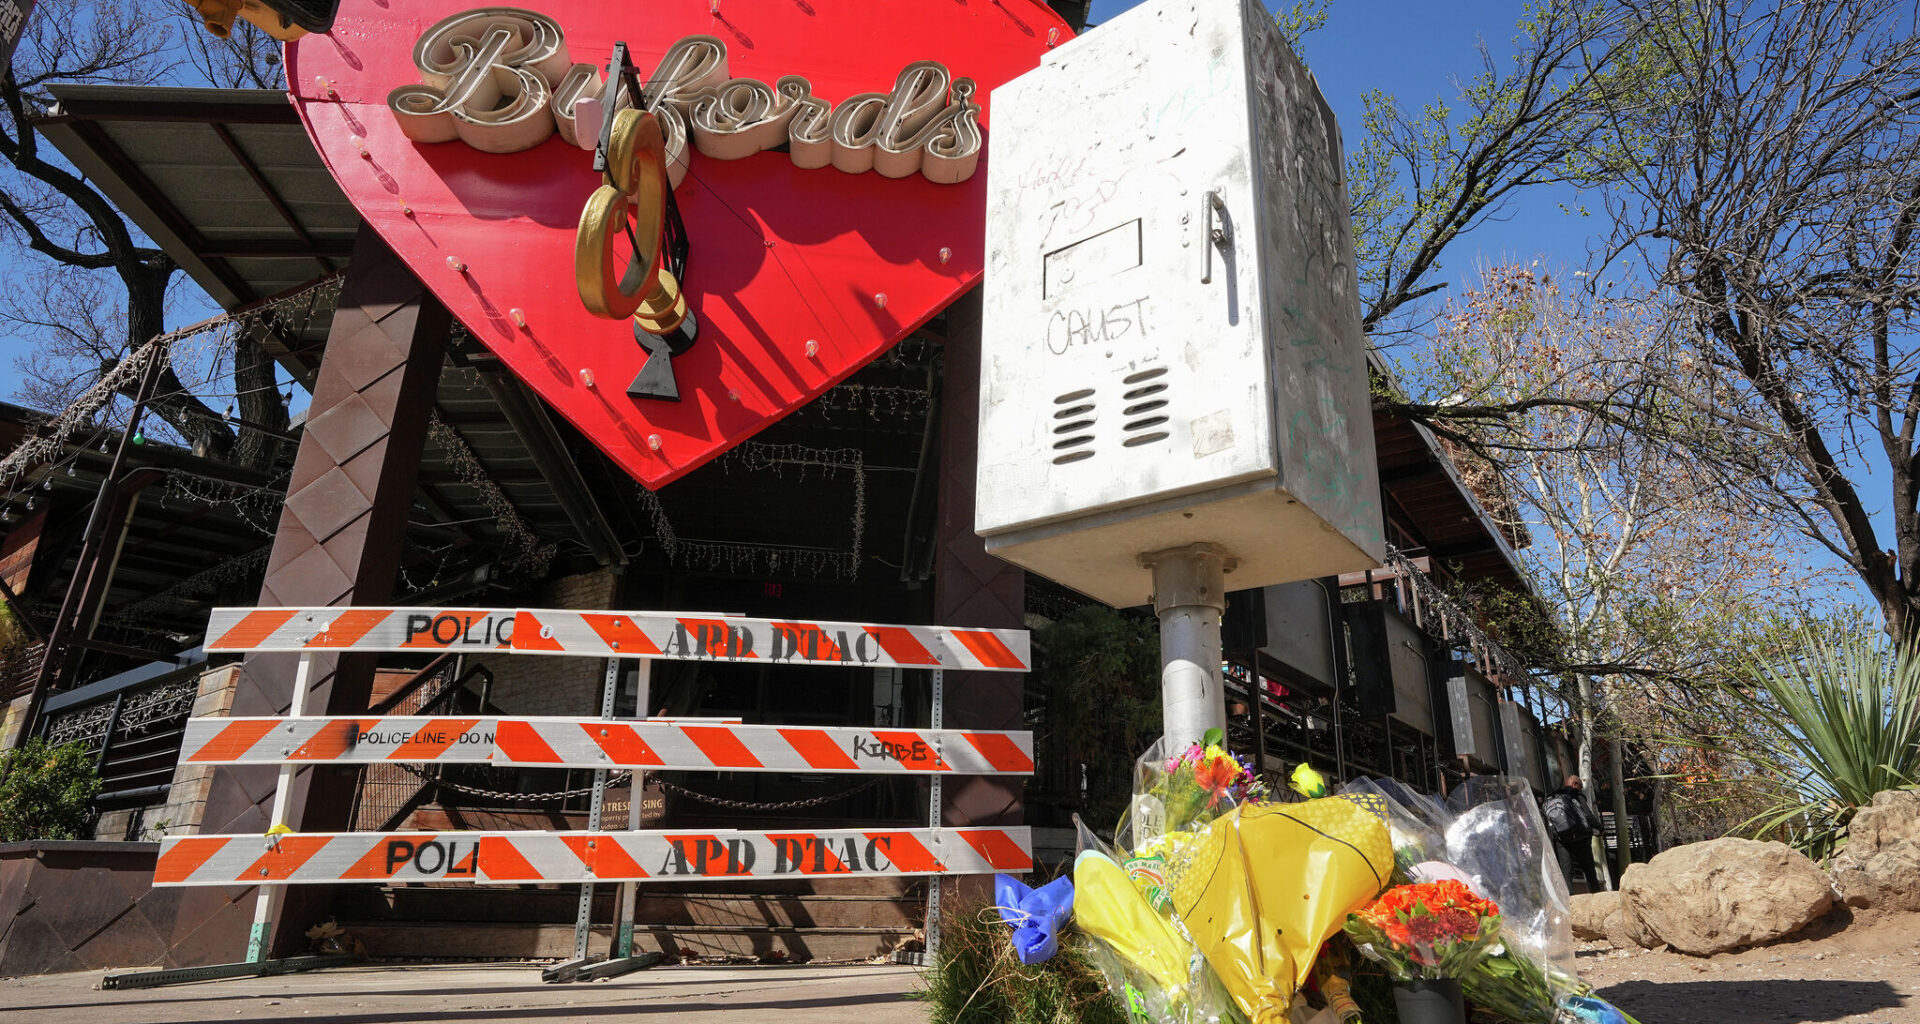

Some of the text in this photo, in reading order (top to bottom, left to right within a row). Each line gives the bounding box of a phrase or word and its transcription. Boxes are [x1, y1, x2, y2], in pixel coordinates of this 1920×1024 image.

[406, 614, 515, 645] POLIC
[663, 623, 880, 664] APD DTAC
[358, 732, 410, 744] POLICE
[415, 733, 446, 744] LINE
[459, 733, 480, 744] DO
[607, 799, 663, 812] TRESSING
[386, 840, 479, 874] POLI
[657, 836, 891, 875] APD DTAC
